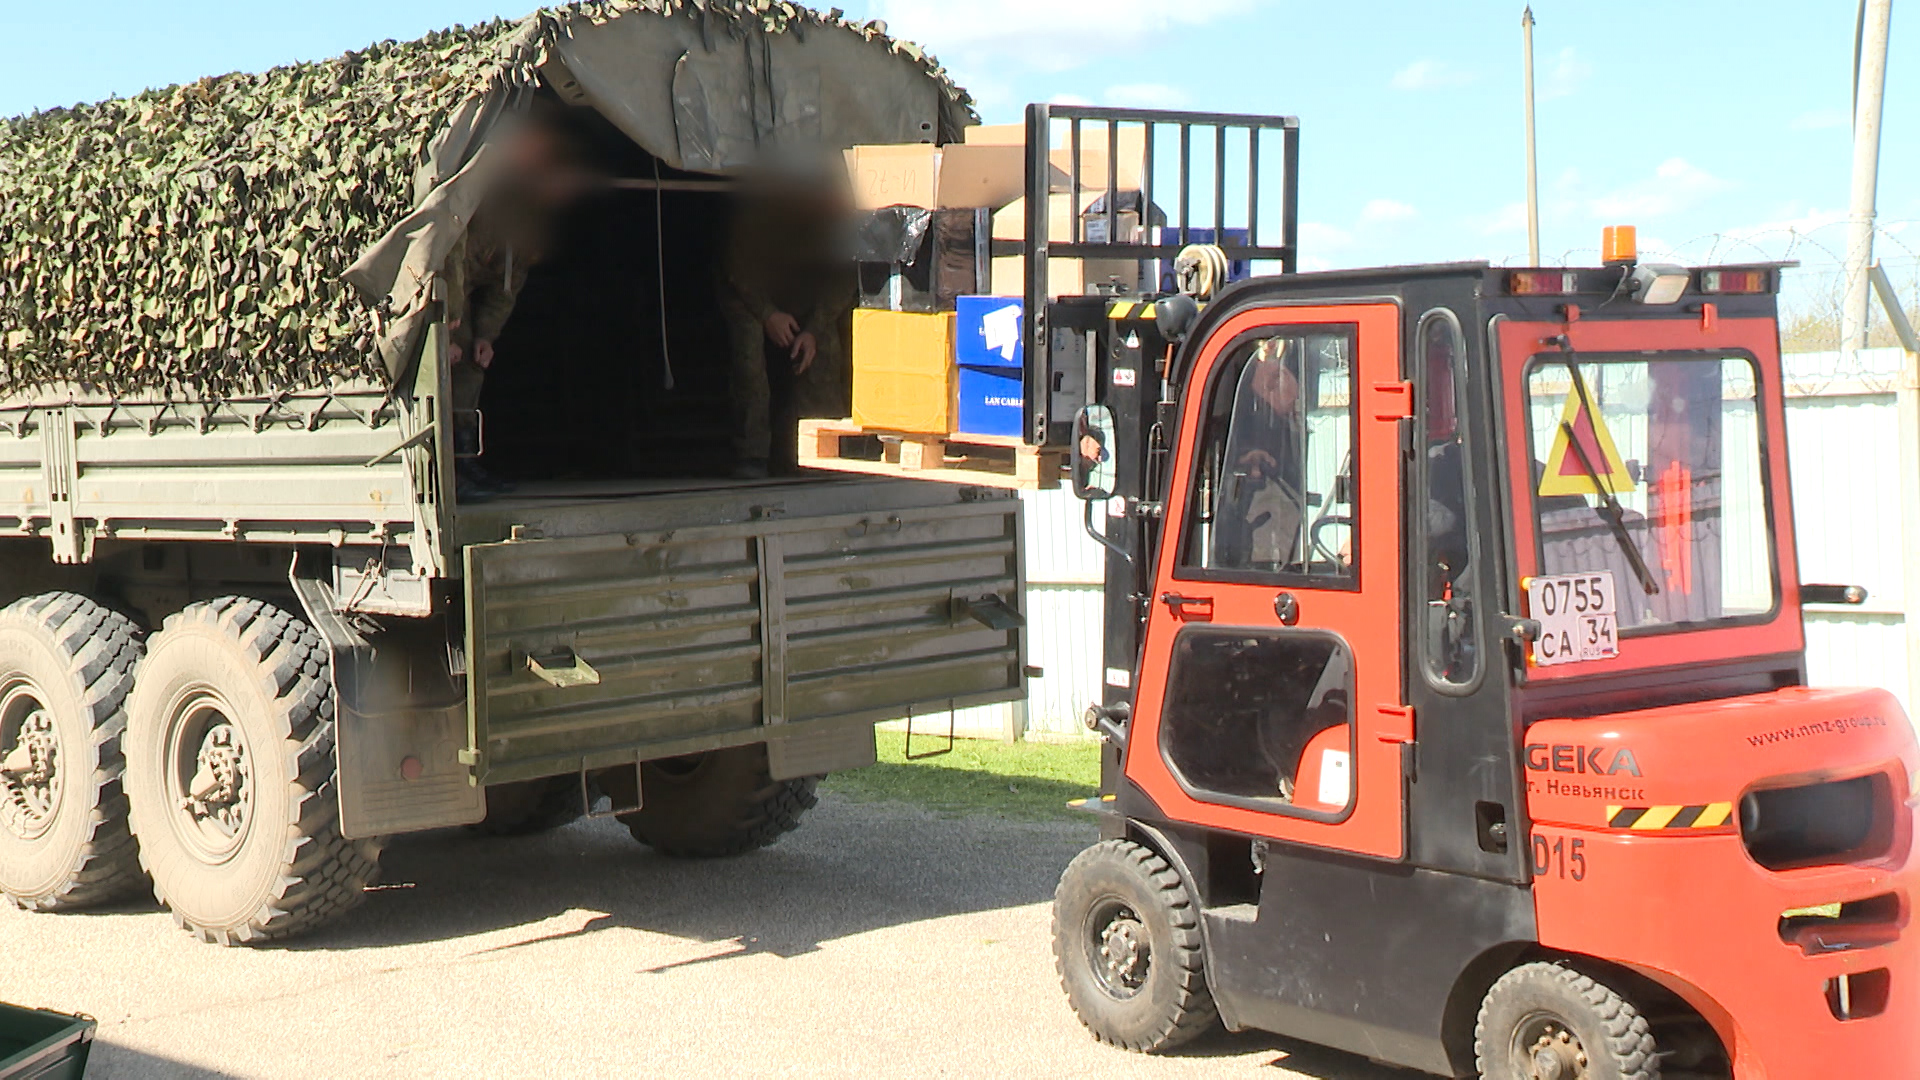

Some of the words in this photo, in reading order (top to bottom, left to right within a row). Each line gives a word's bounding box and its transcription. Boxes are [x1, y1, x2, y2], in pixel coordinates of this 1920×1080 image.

[1542, 577, 1604, 616] 0755
[1587, 617, 1612, 644] 34
[1746, 715, 1887, 747] www.nmz-group.ru
[1524, 743, 1643, 777] GEKA
[1547, 779, 1644, 800] Невьянск
[1533, 834, 1586, 882] D15
